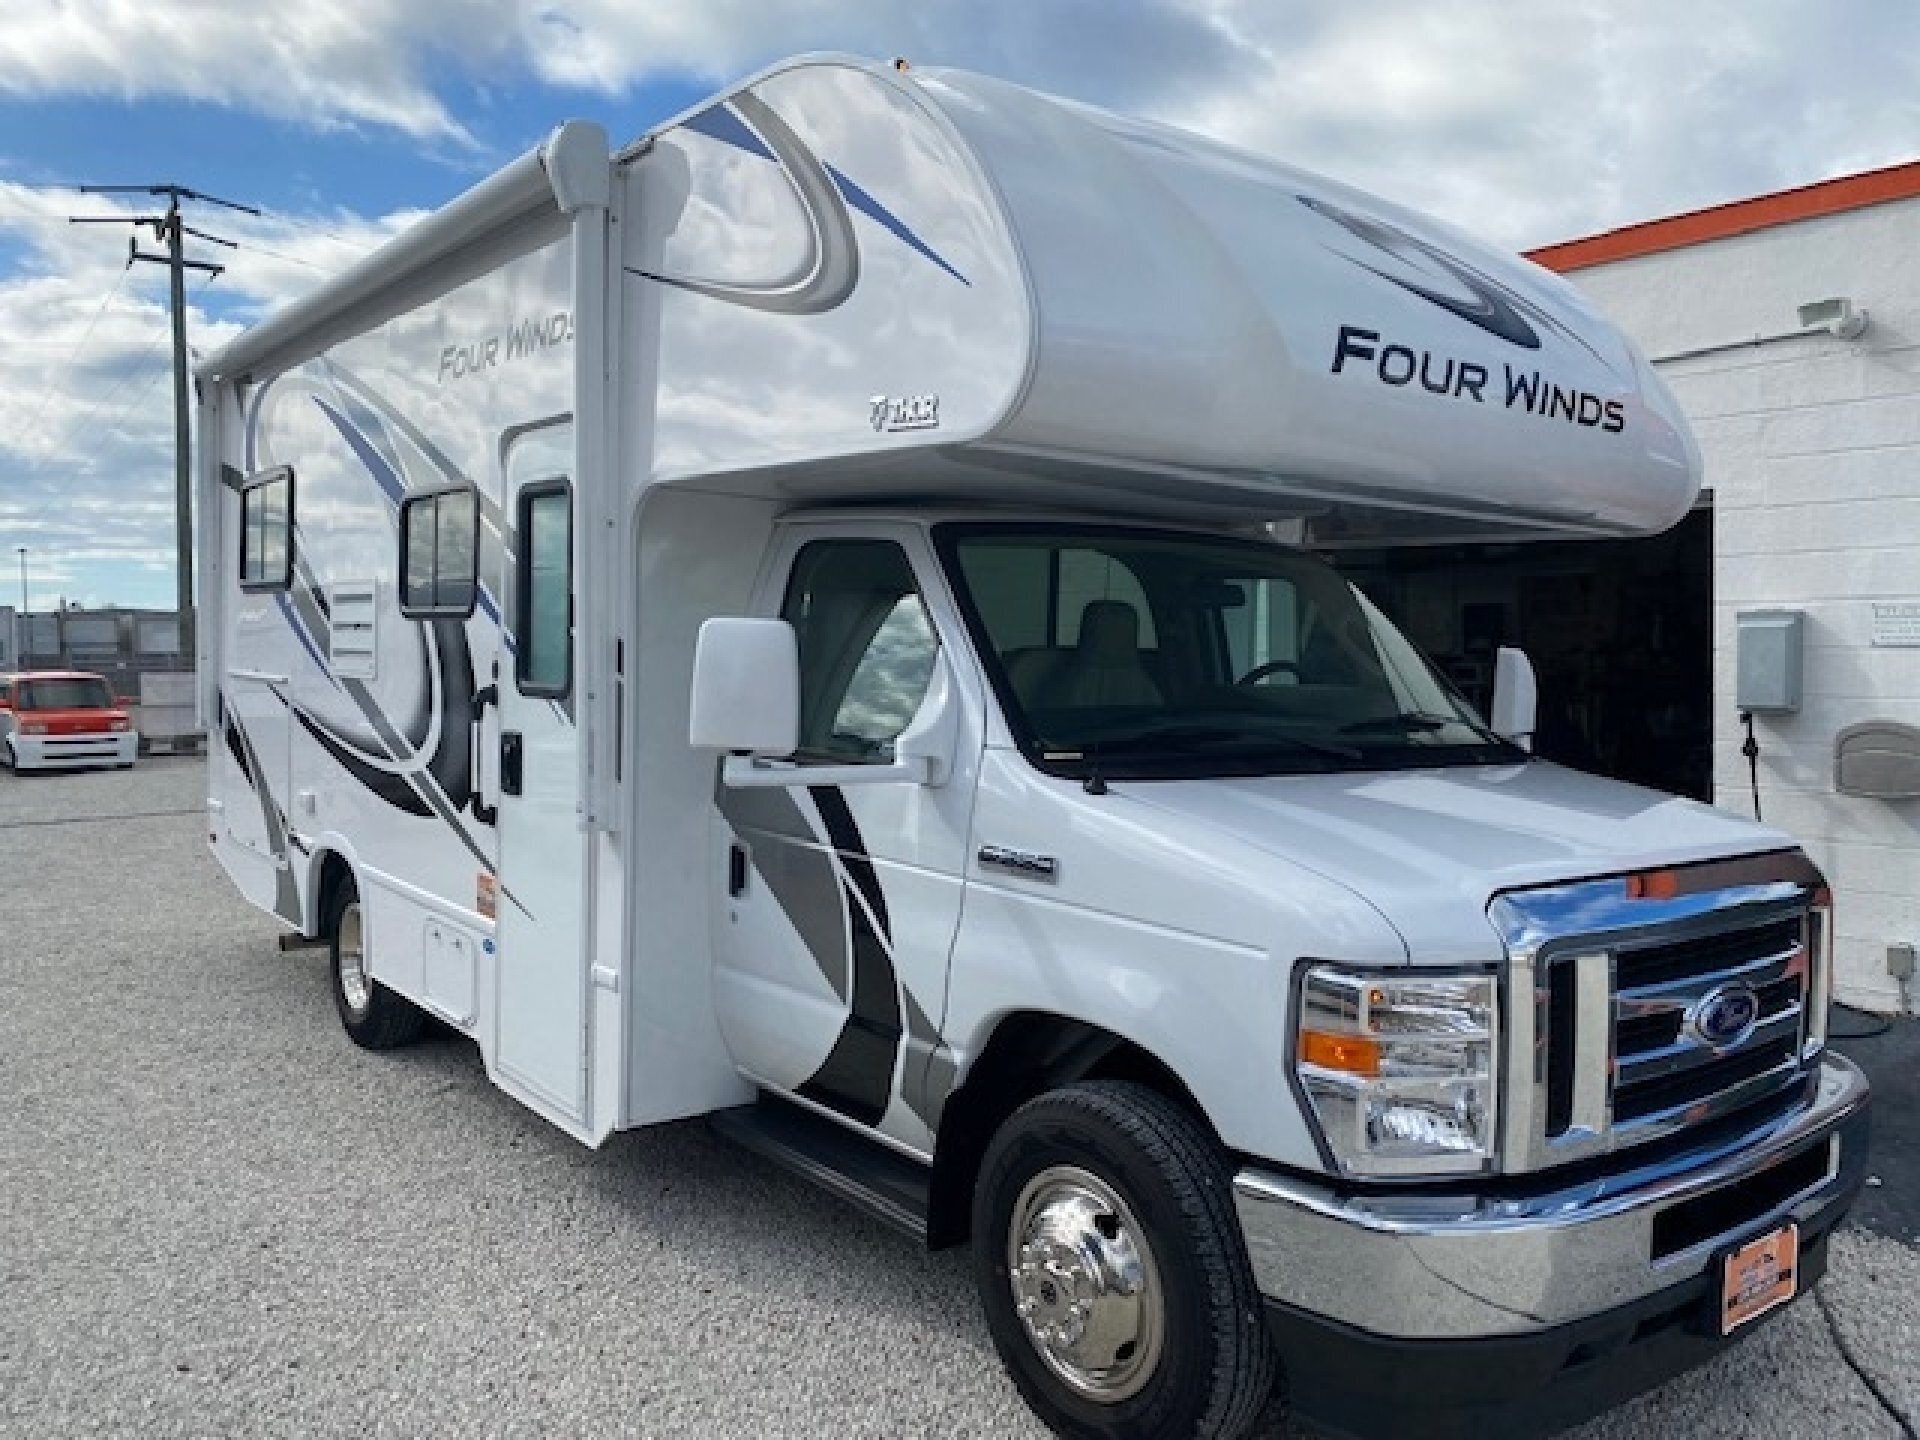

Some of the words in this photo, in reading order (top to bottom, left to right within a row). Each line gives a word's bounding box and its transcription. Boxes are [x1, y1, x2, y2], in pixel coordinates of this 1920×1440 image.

[437, 336, 498, 384] FOUR
[1331, 325, 1487, 402] FOUR
[1504, 364, 1625, 432] WINDS
